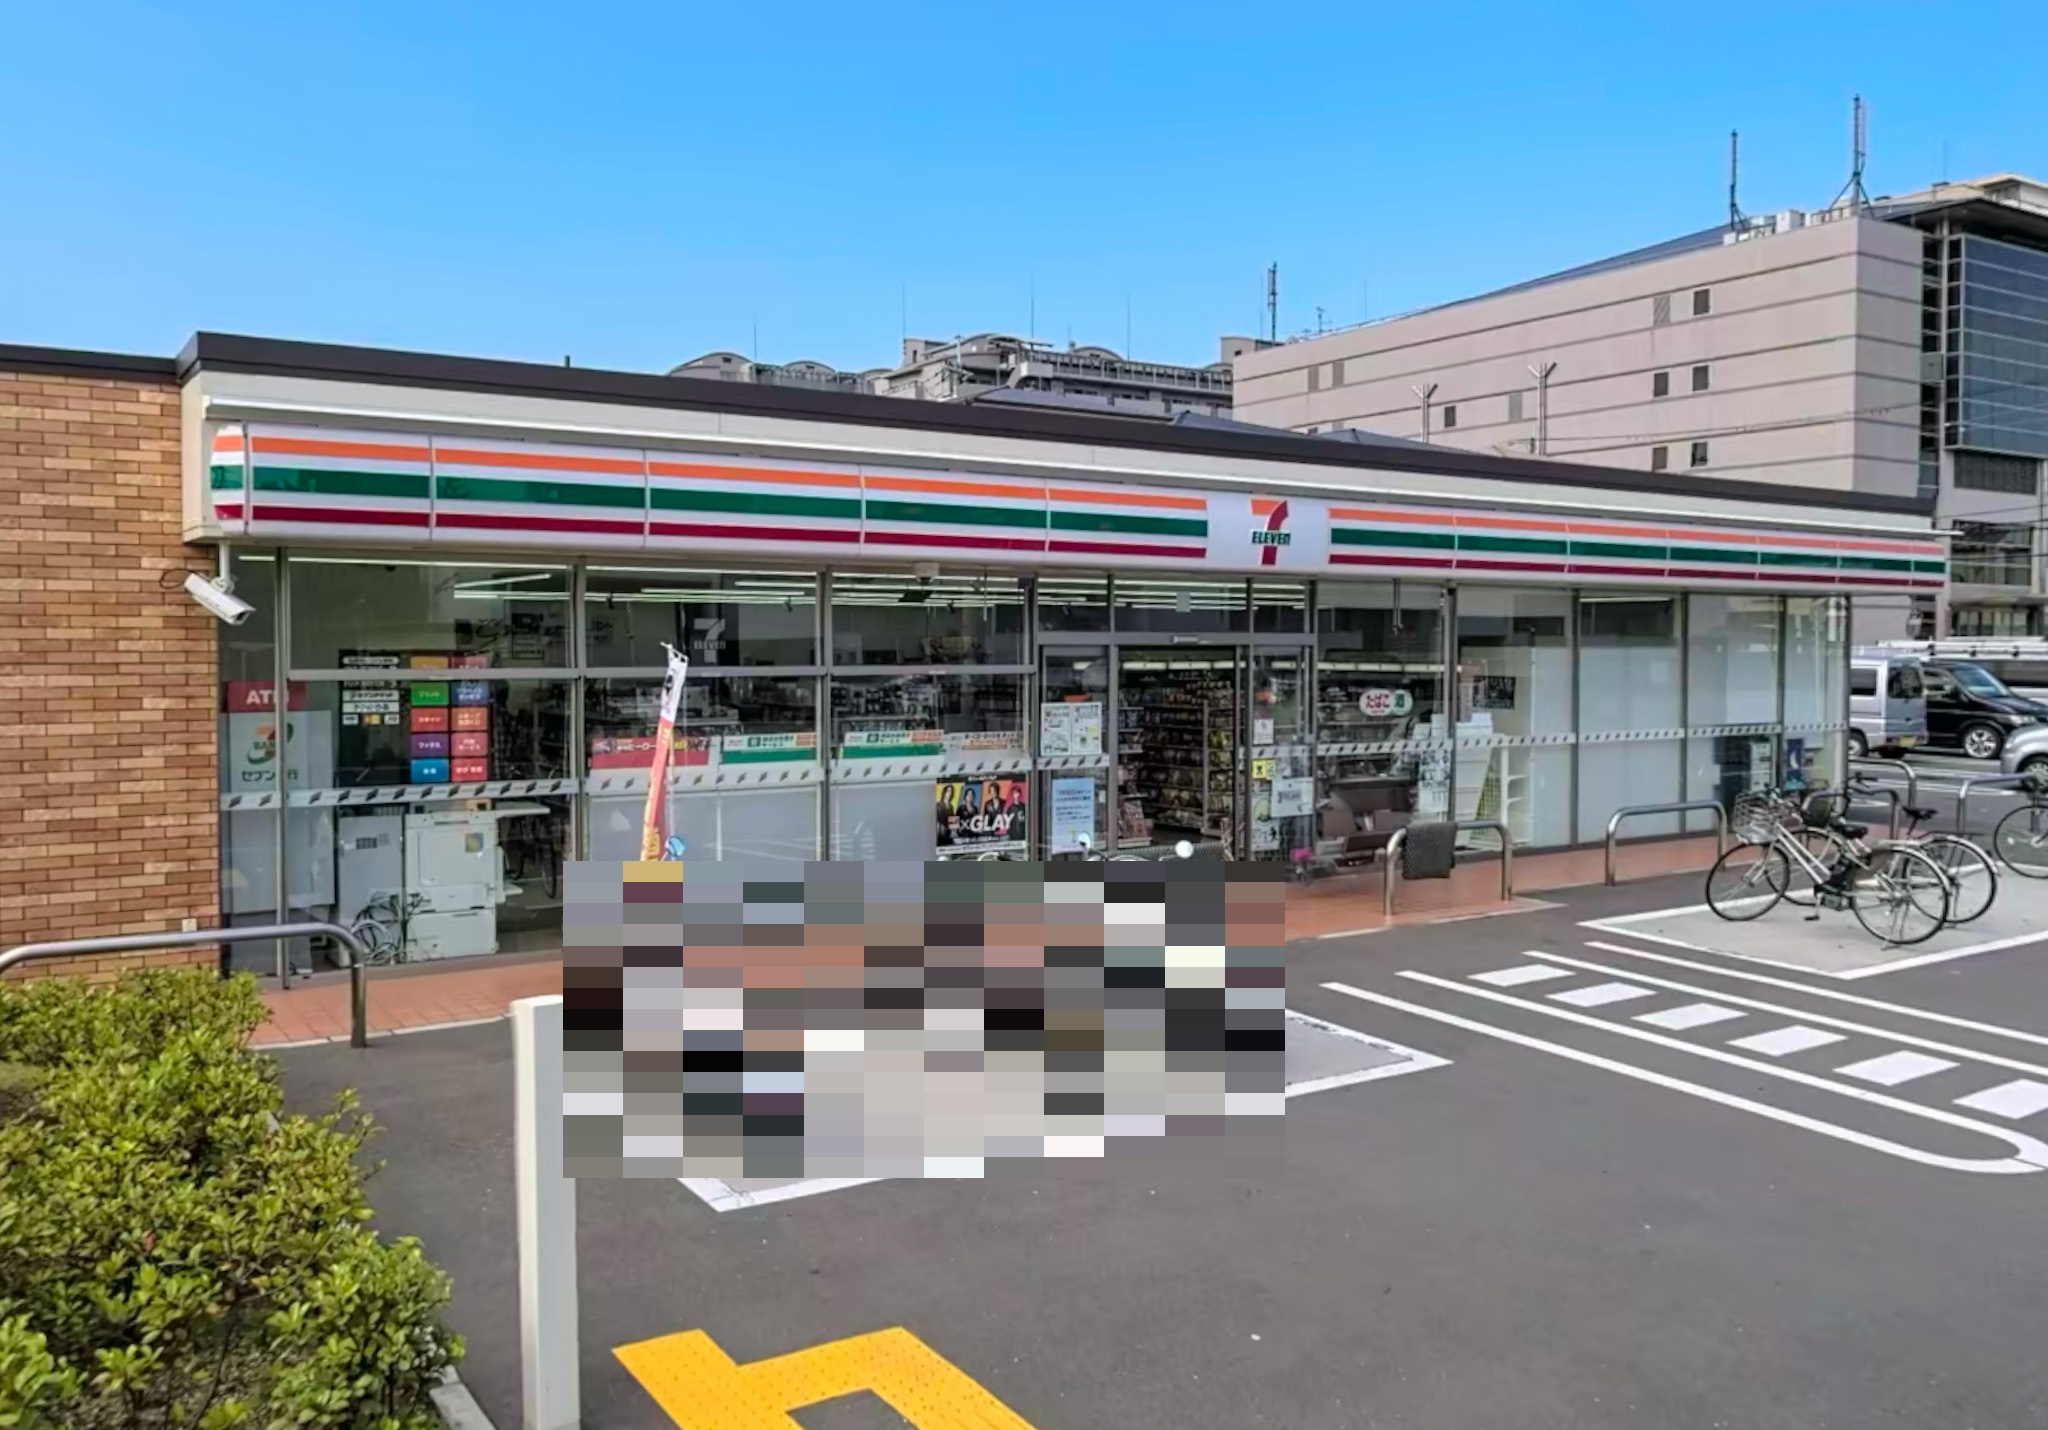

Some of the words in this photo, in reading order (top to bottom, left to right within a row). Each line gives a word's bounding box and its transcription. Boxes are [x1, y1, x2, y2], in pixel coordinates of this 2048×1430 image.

[1251, 499, 1289, 565] 7
[693, 618, 726, 663] 7
[241, 769, 299, 782] セブン行
[970, 812, 1016, 833] GLAY
